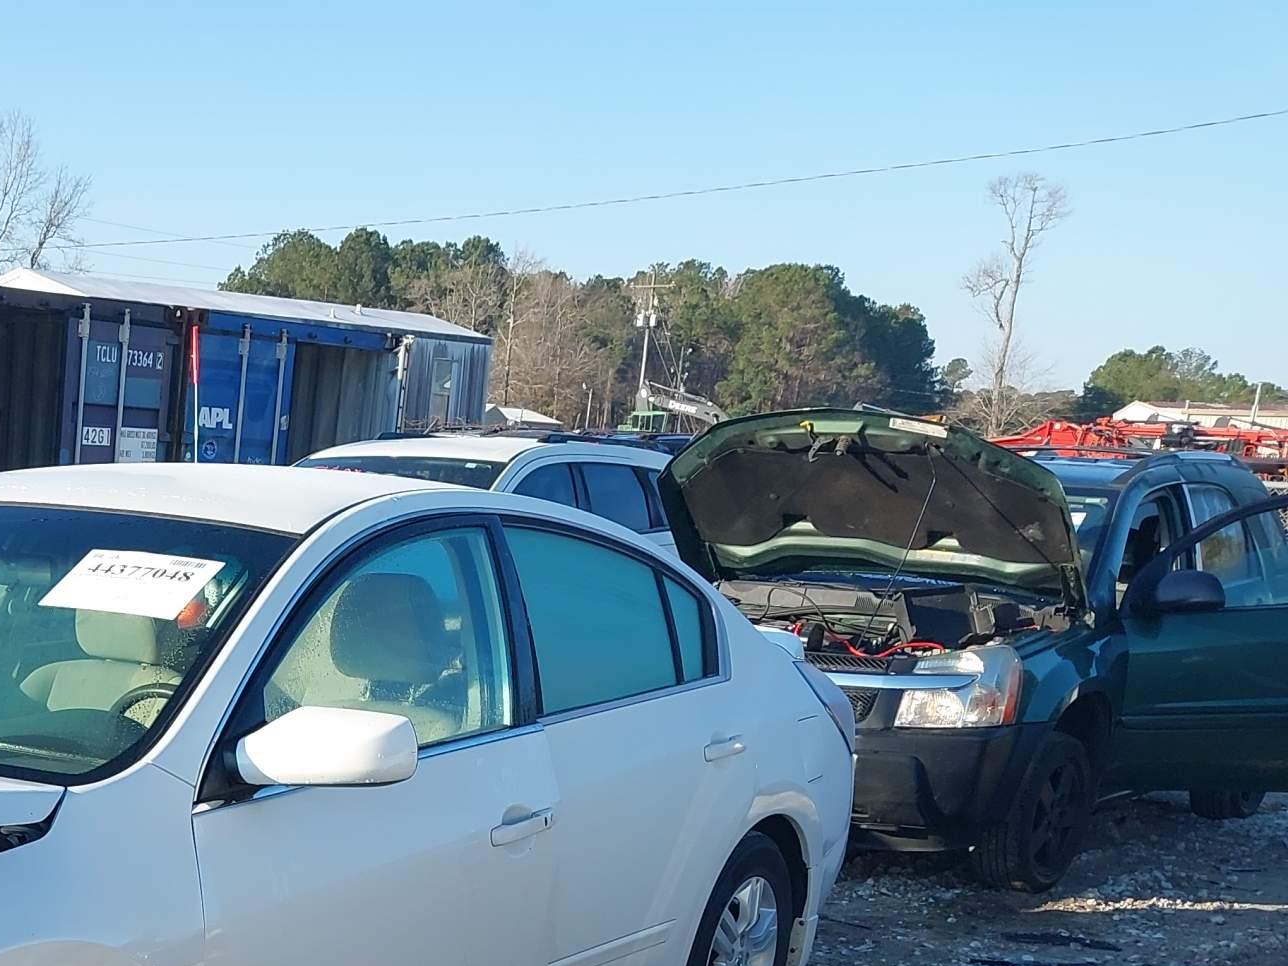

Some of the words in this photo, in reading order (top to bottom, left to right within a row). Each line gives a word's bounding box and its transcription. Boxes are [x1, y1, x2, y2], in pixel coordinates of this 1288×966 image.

[96, 345, 118, 363] TCLU
[199, 406, 233, 430] APL
[88, 563, 195, 583] 44377048
